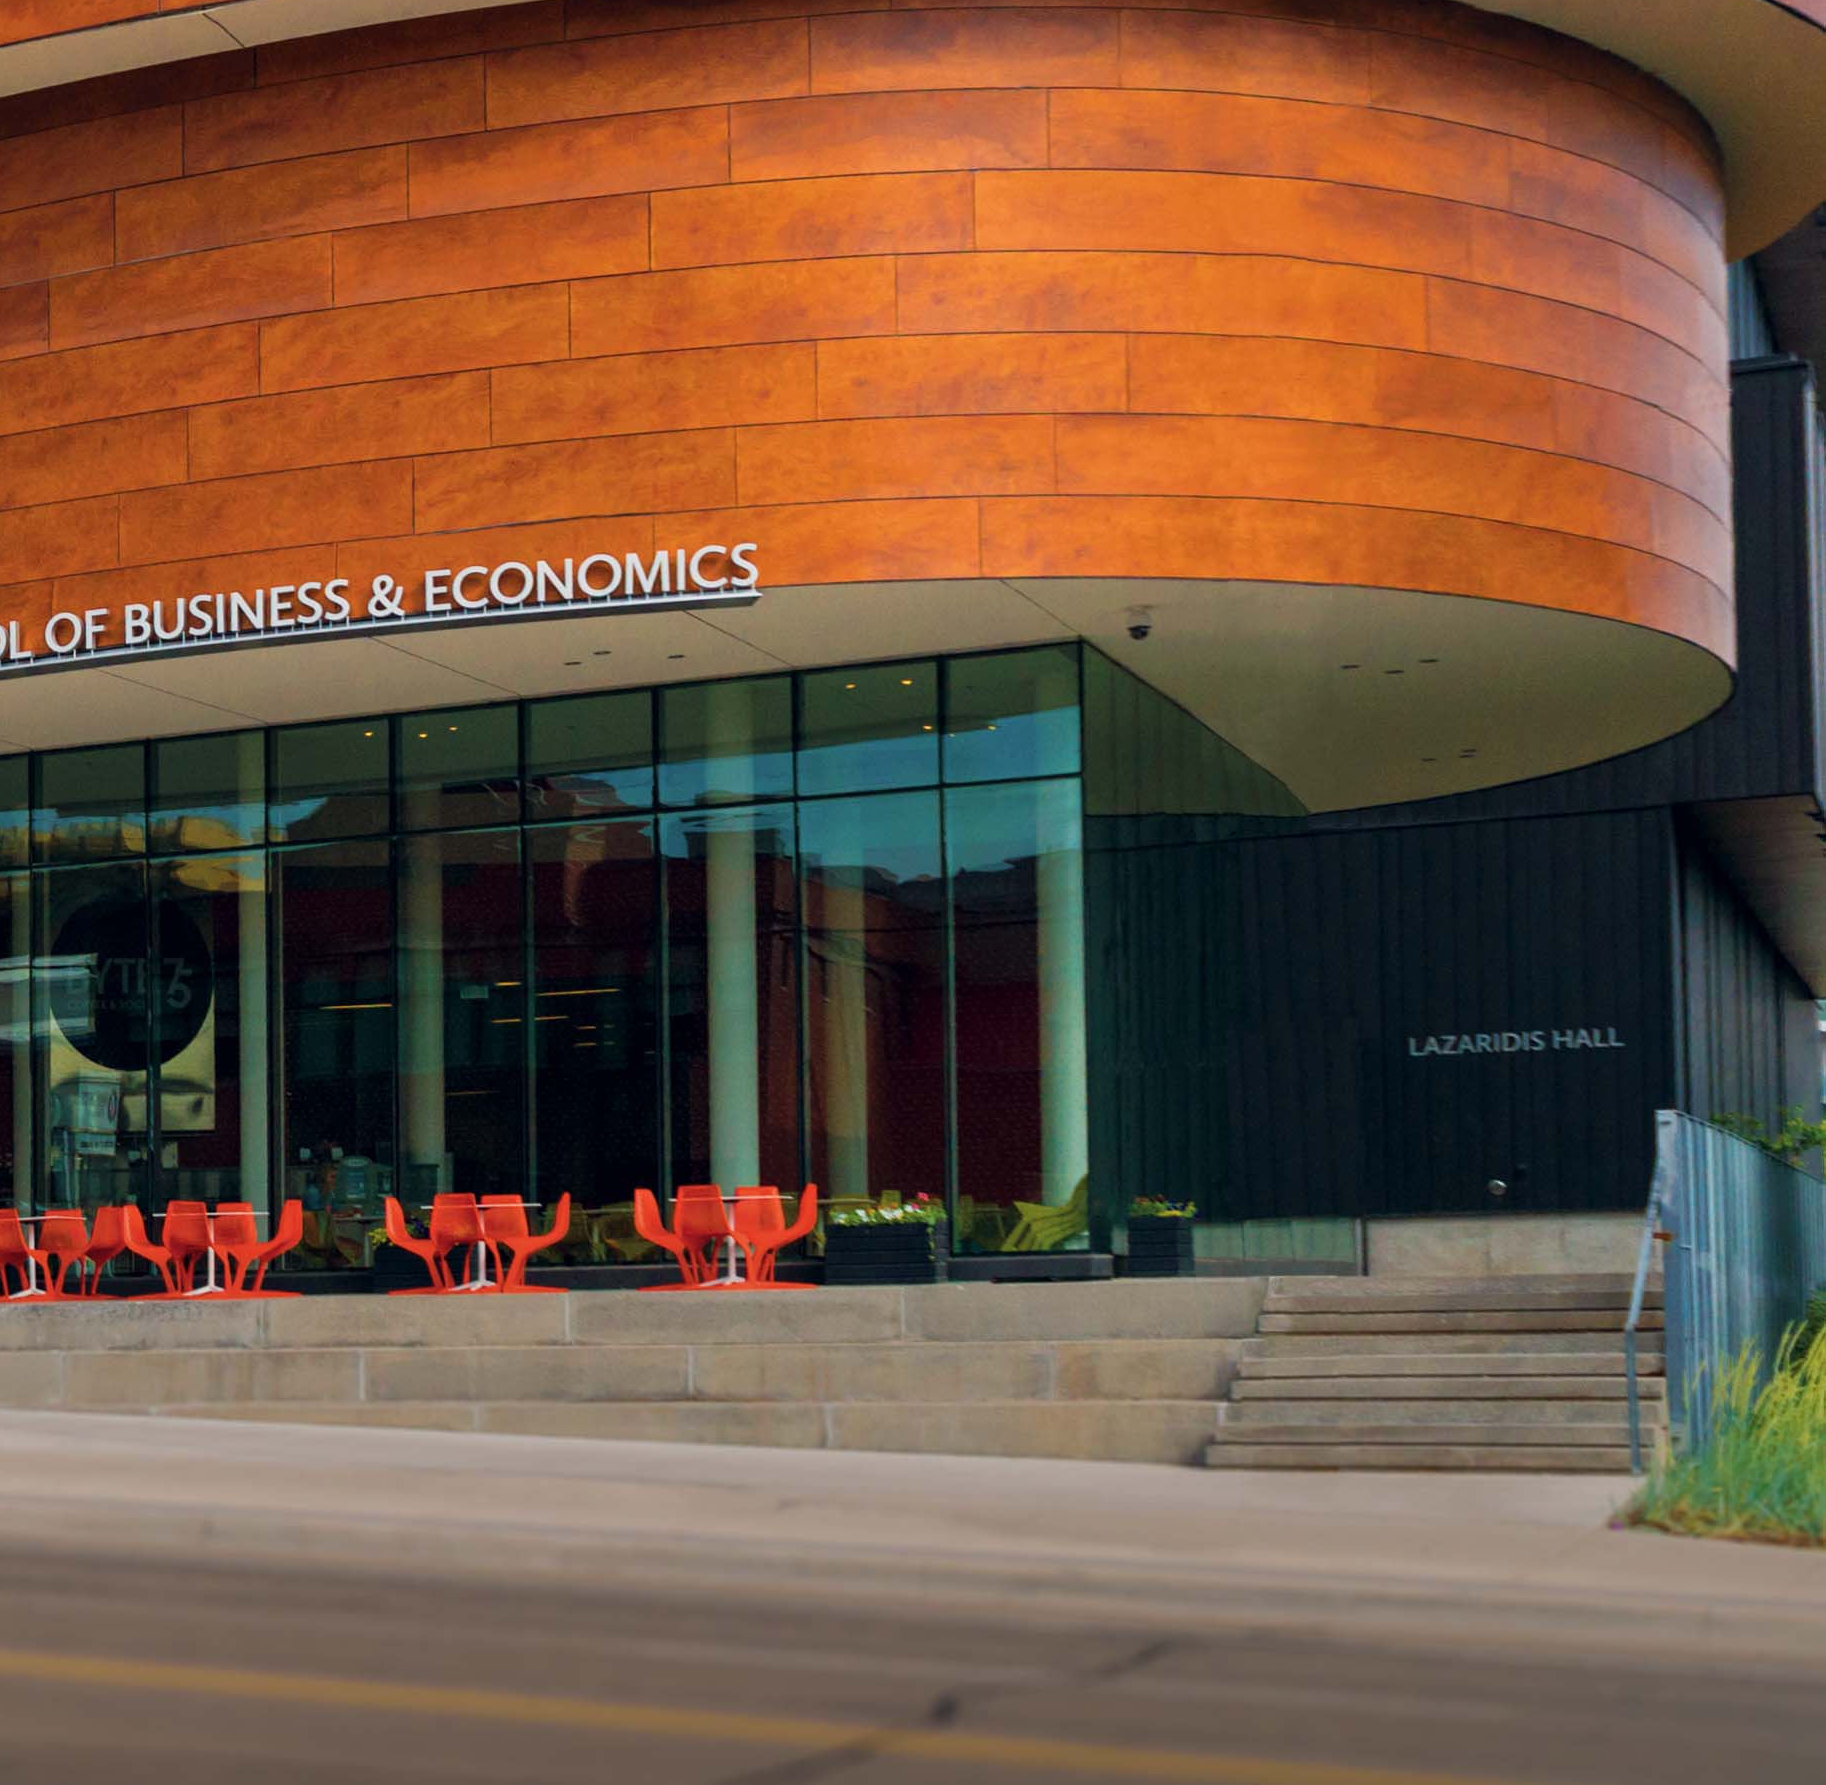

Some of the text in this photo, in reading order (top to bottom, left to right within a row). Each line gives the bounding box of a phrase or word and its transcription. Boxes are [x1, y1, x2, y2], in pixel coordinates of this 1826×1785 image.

[44, 608, 110, 653] OF
[124, 578, 351, 646] BUSINESS
[367, 573, 406, 618] &
[424, 542, 760, 613] ECONOMICS
[1409, 1026, 1627, 1057] LAZARIDIS HALL
